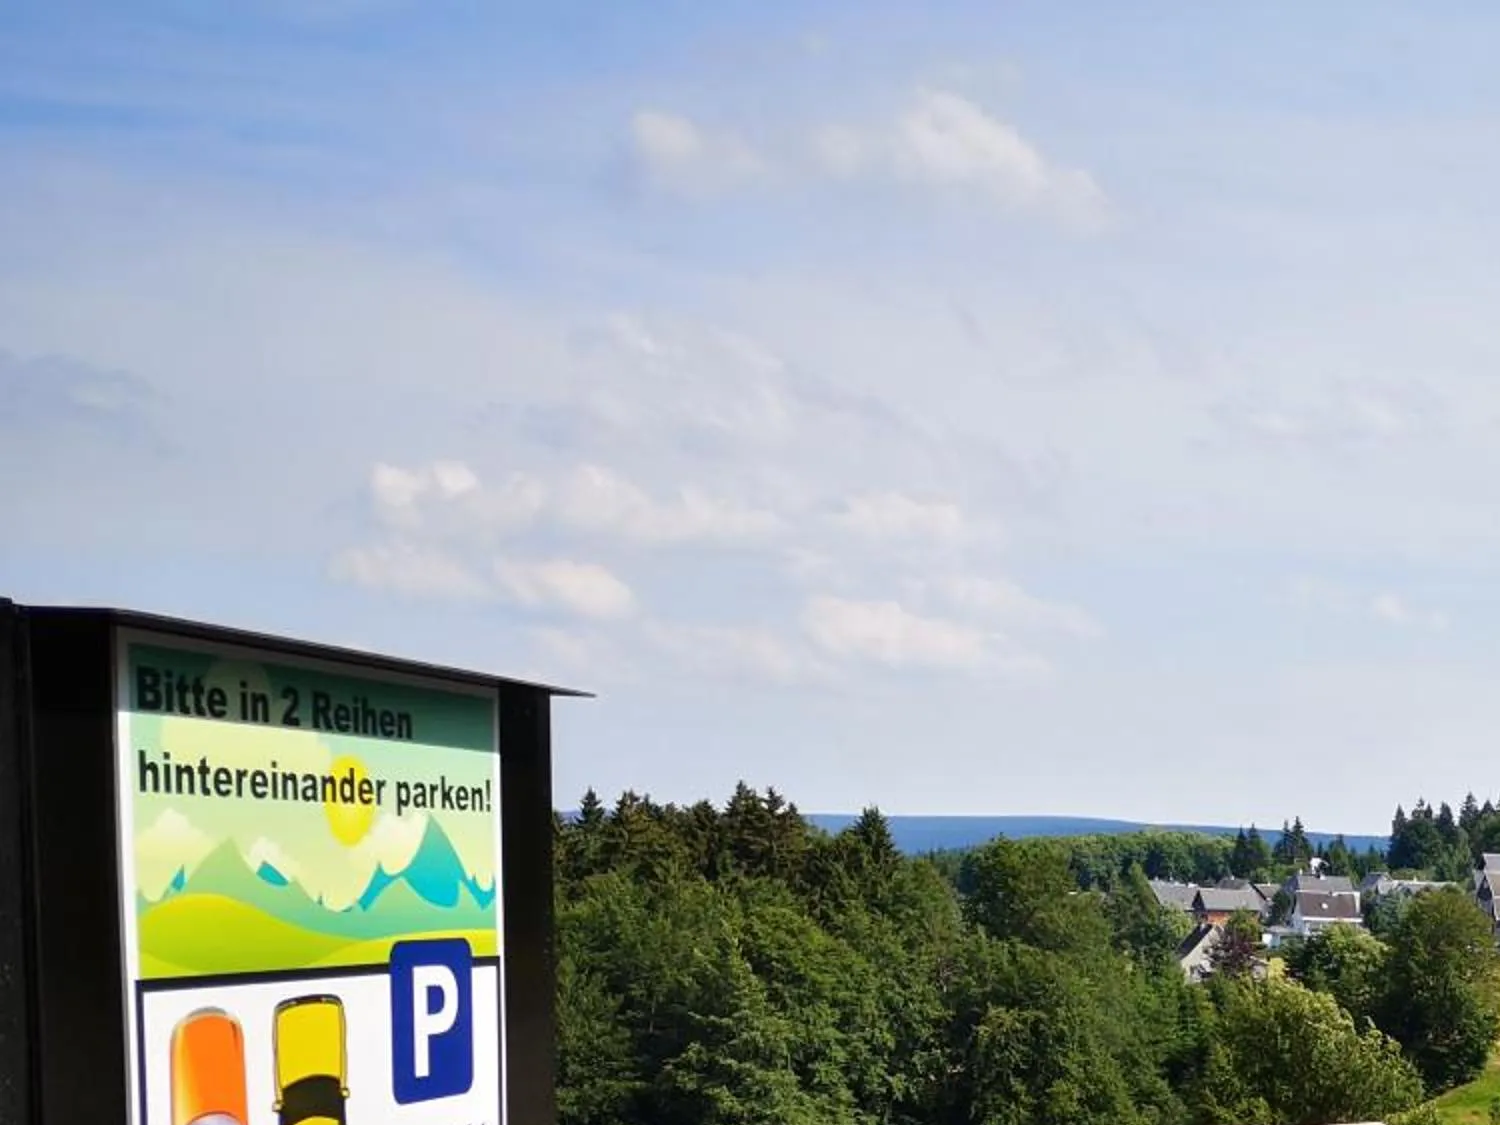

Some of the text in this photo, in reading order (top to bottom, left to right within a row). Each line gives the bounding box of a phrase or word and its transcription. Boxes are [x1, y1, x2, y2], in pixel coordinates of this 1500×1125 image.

[136, 665, 413, 740] Bitte in 2 Reihen
[138, 749, 492, 817] hintereinander parken!
[412, 964, 459, 1080] P
